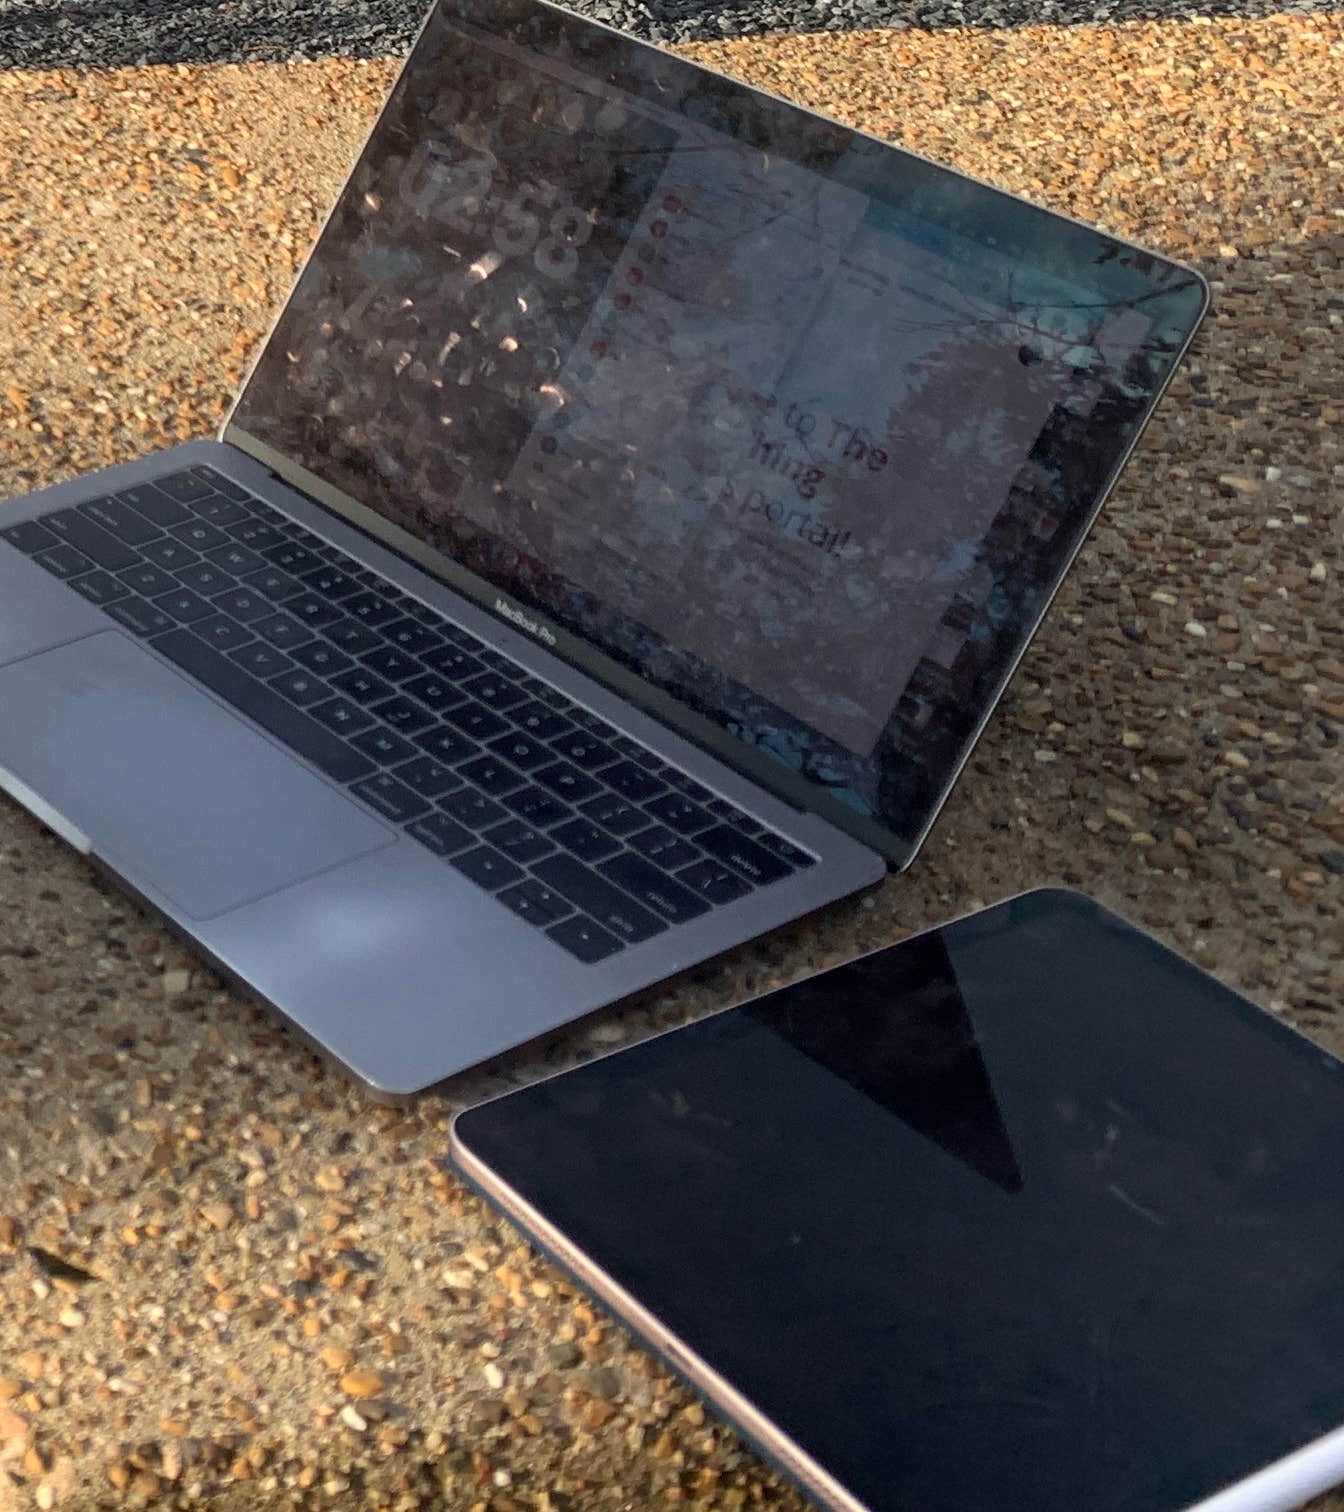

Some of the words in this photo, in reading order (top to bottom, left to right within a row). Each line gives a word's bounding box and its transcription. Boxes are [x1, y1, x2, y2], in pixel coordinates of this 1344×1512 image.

[827, 418, 889, 472] The
[495, 599, 538, 634] MacBook
[538, 626, 557, 646] Pro
